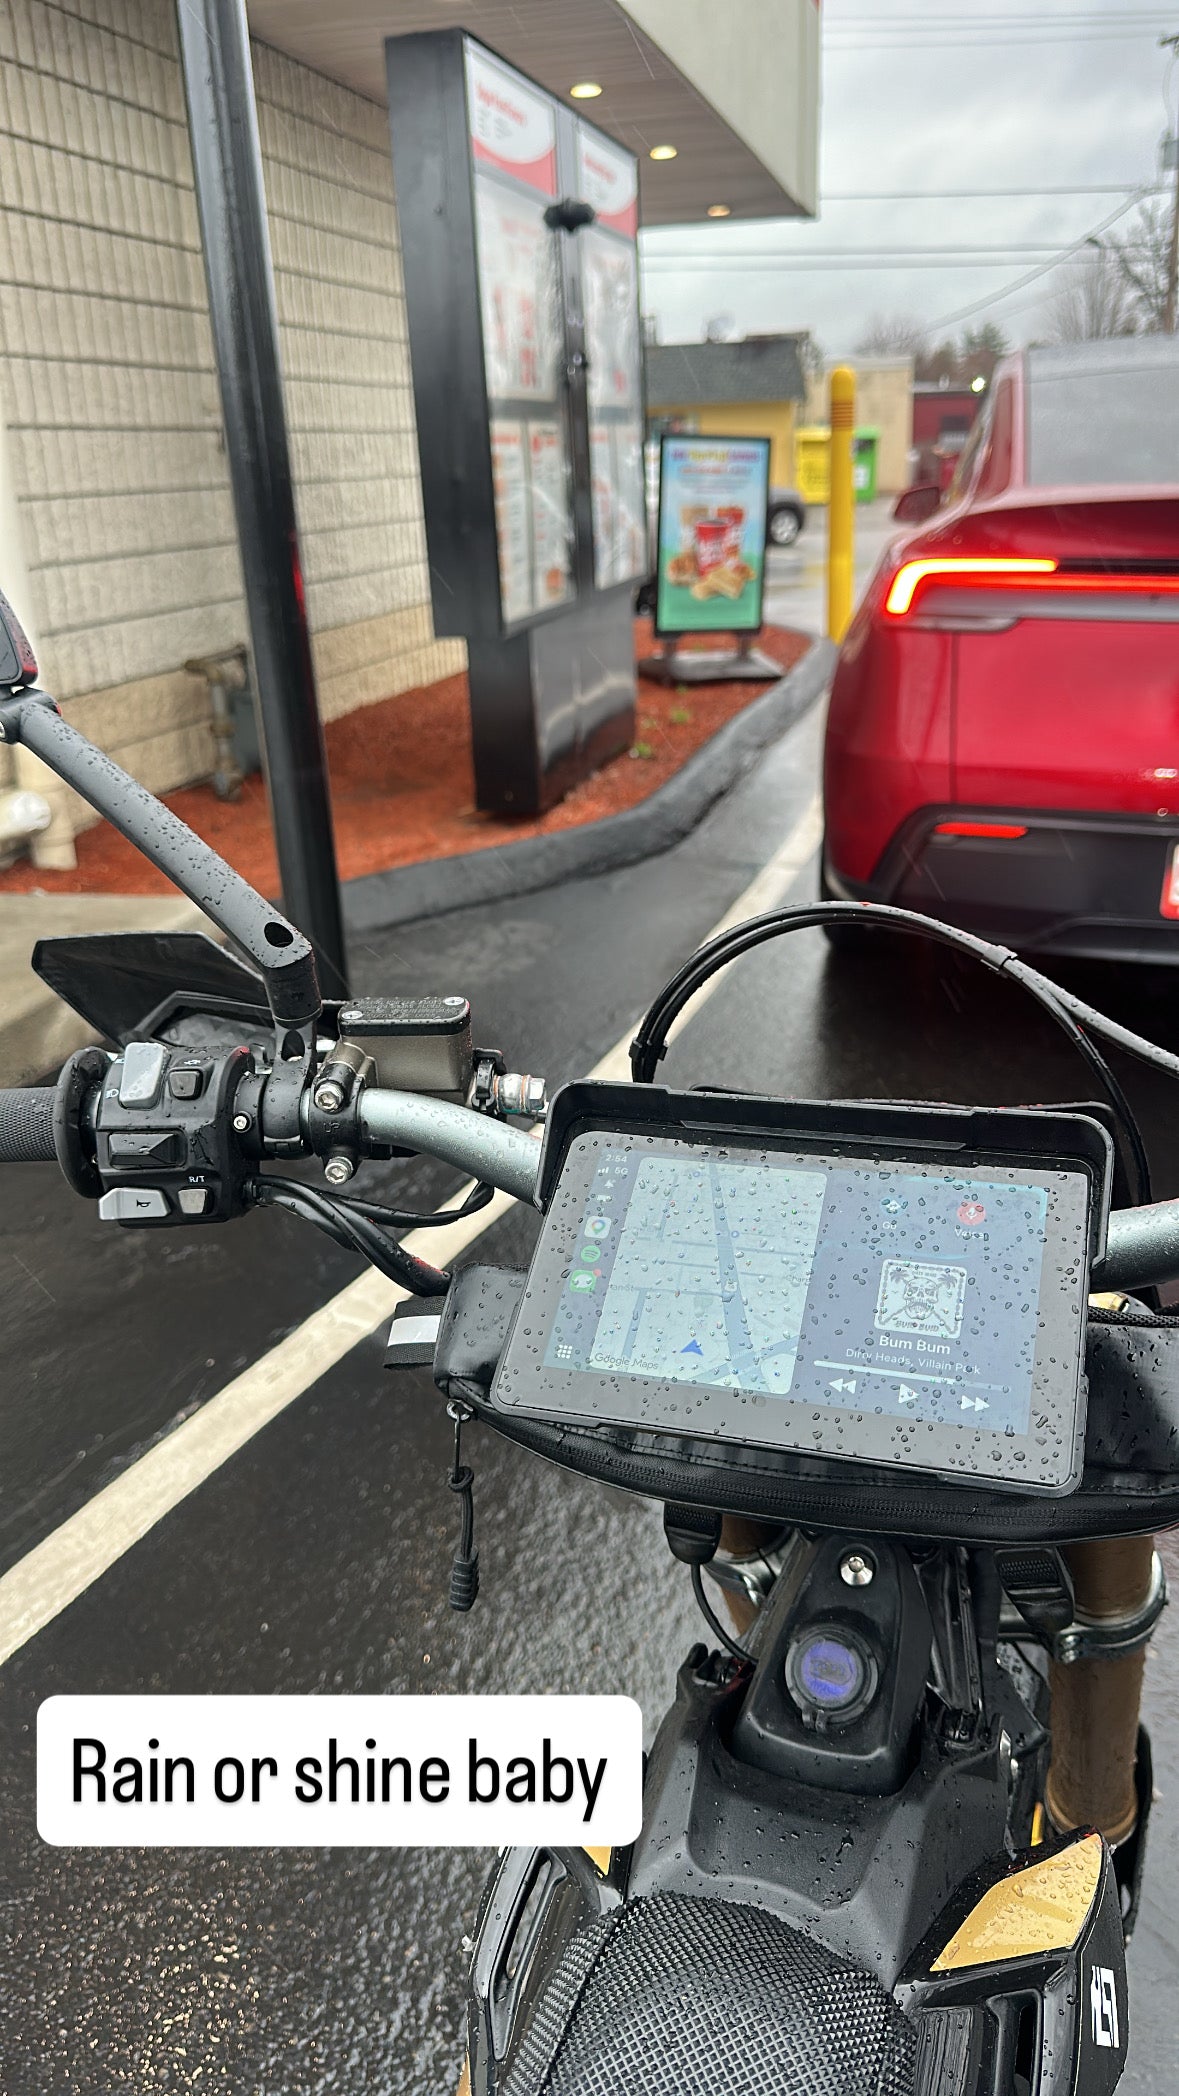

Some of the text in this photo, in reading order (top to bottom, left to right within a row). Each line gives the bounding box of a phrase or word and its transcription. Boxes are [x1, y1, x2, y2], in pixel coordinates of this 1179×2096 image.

[605, 1154, 628, 1163] 2:54
[614, 1166, 629, 1175] 5G
[188, 1175, 206, 1184] R/T
[879, 1335, 951, 1355] Bum Bum
[594, 1352, 659, 1371] Google Maps
[875, 1351, 914, 1367] Heads,
[918, 1358, 952, 1371] Villain
